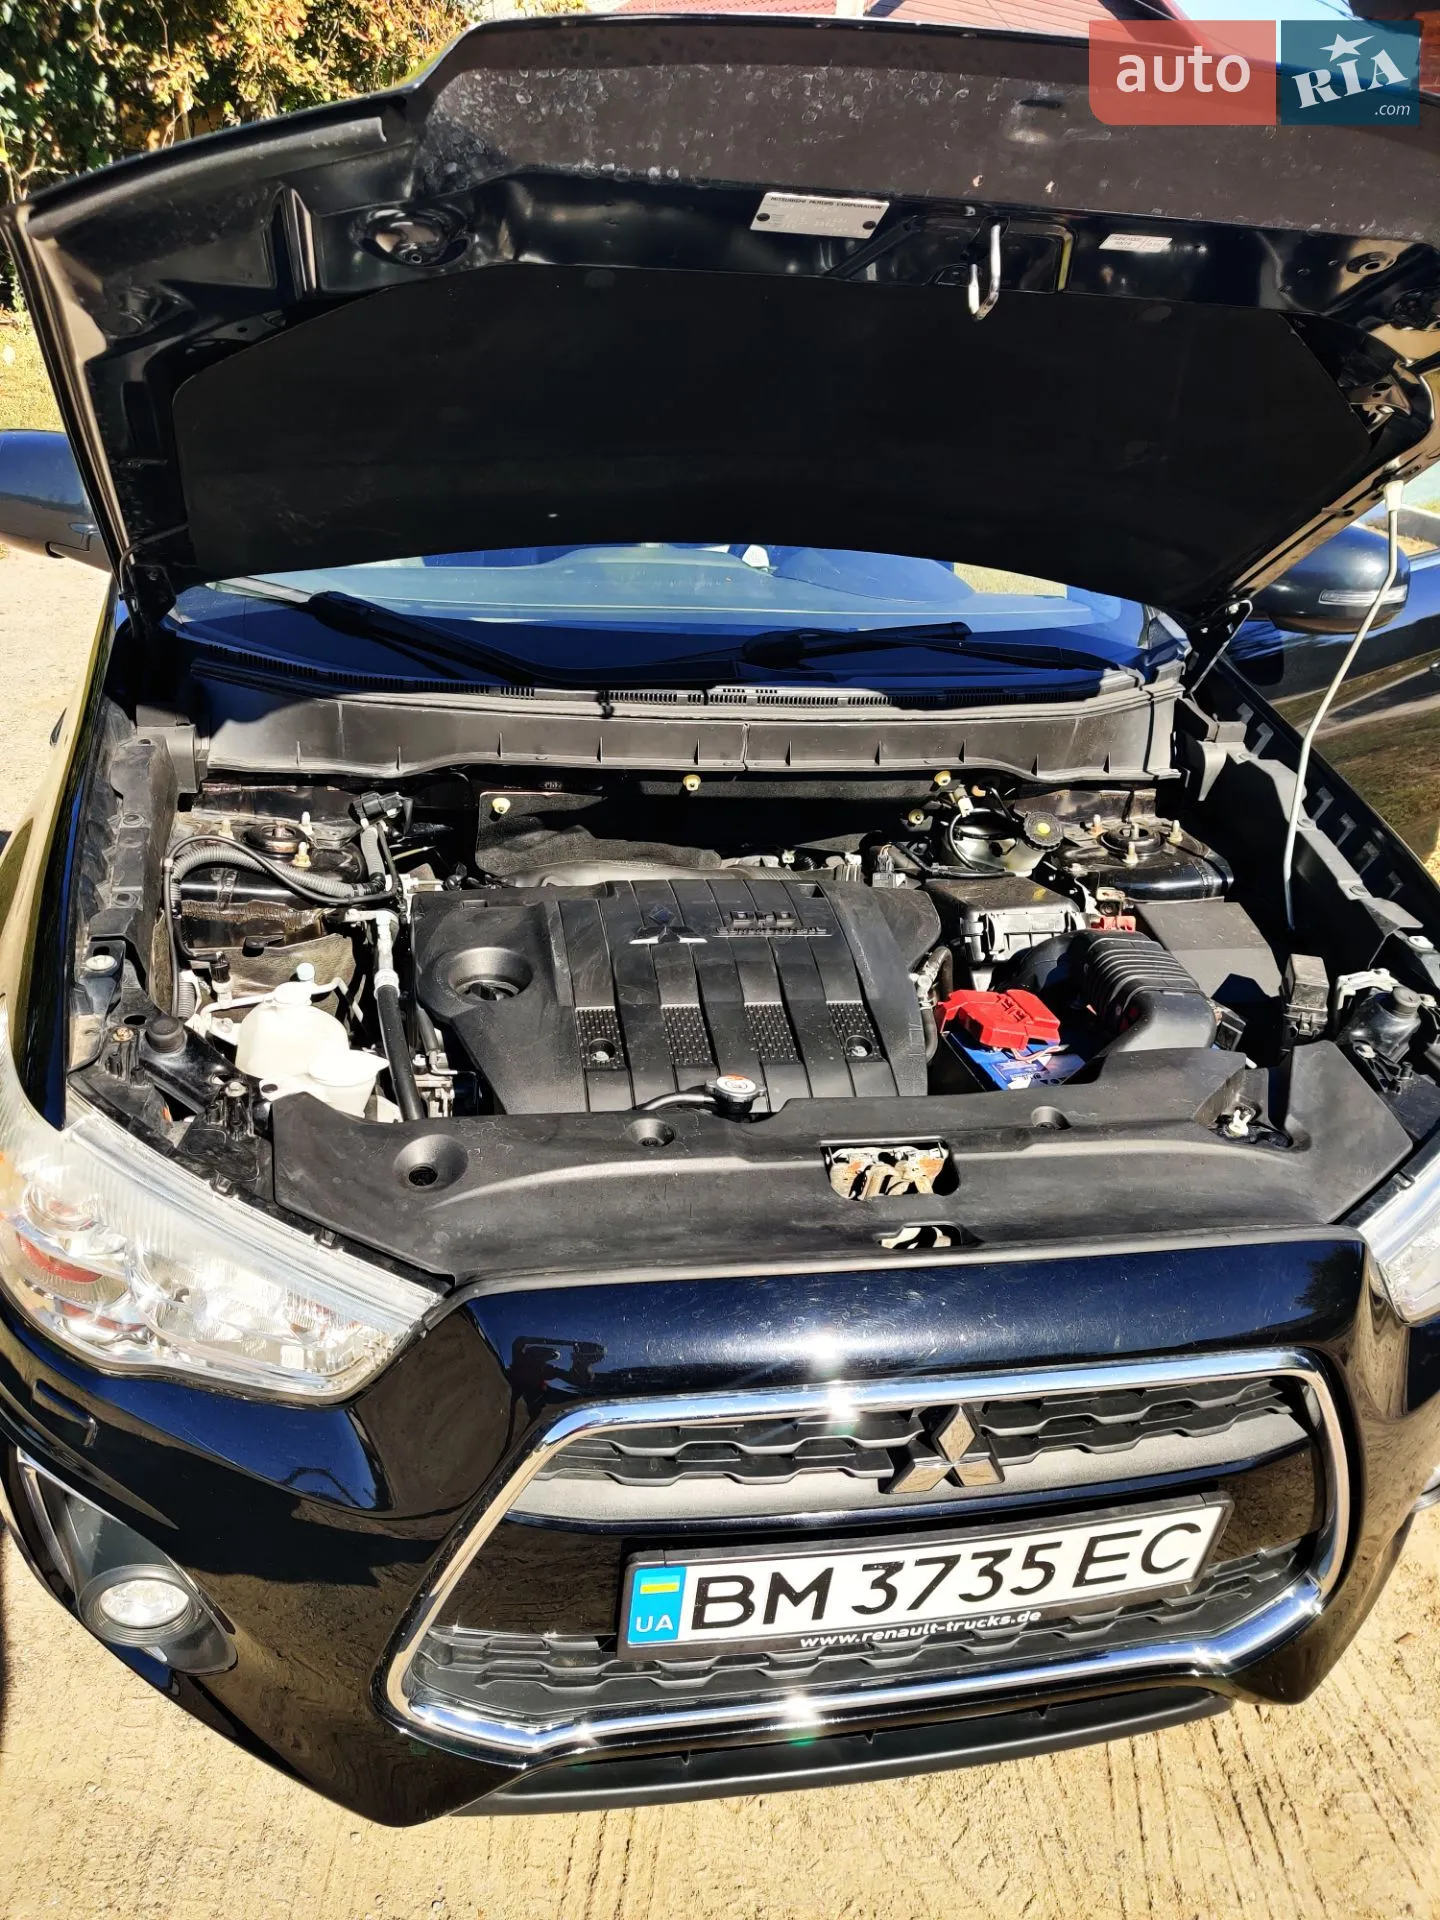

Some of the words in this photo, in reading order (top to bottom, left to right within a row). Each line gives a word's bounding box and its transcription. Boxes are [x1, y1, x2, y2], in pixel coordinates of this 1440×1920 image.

[691, 1568, 833, 1630] BM
[851, 1541, 1062, 1615] 3735
[1072, 1522, 1202, 1588] EC
[635, 1615, 674, 1633] UA
[800, 1609, 1042, 1647] www.renault-trucks.de
